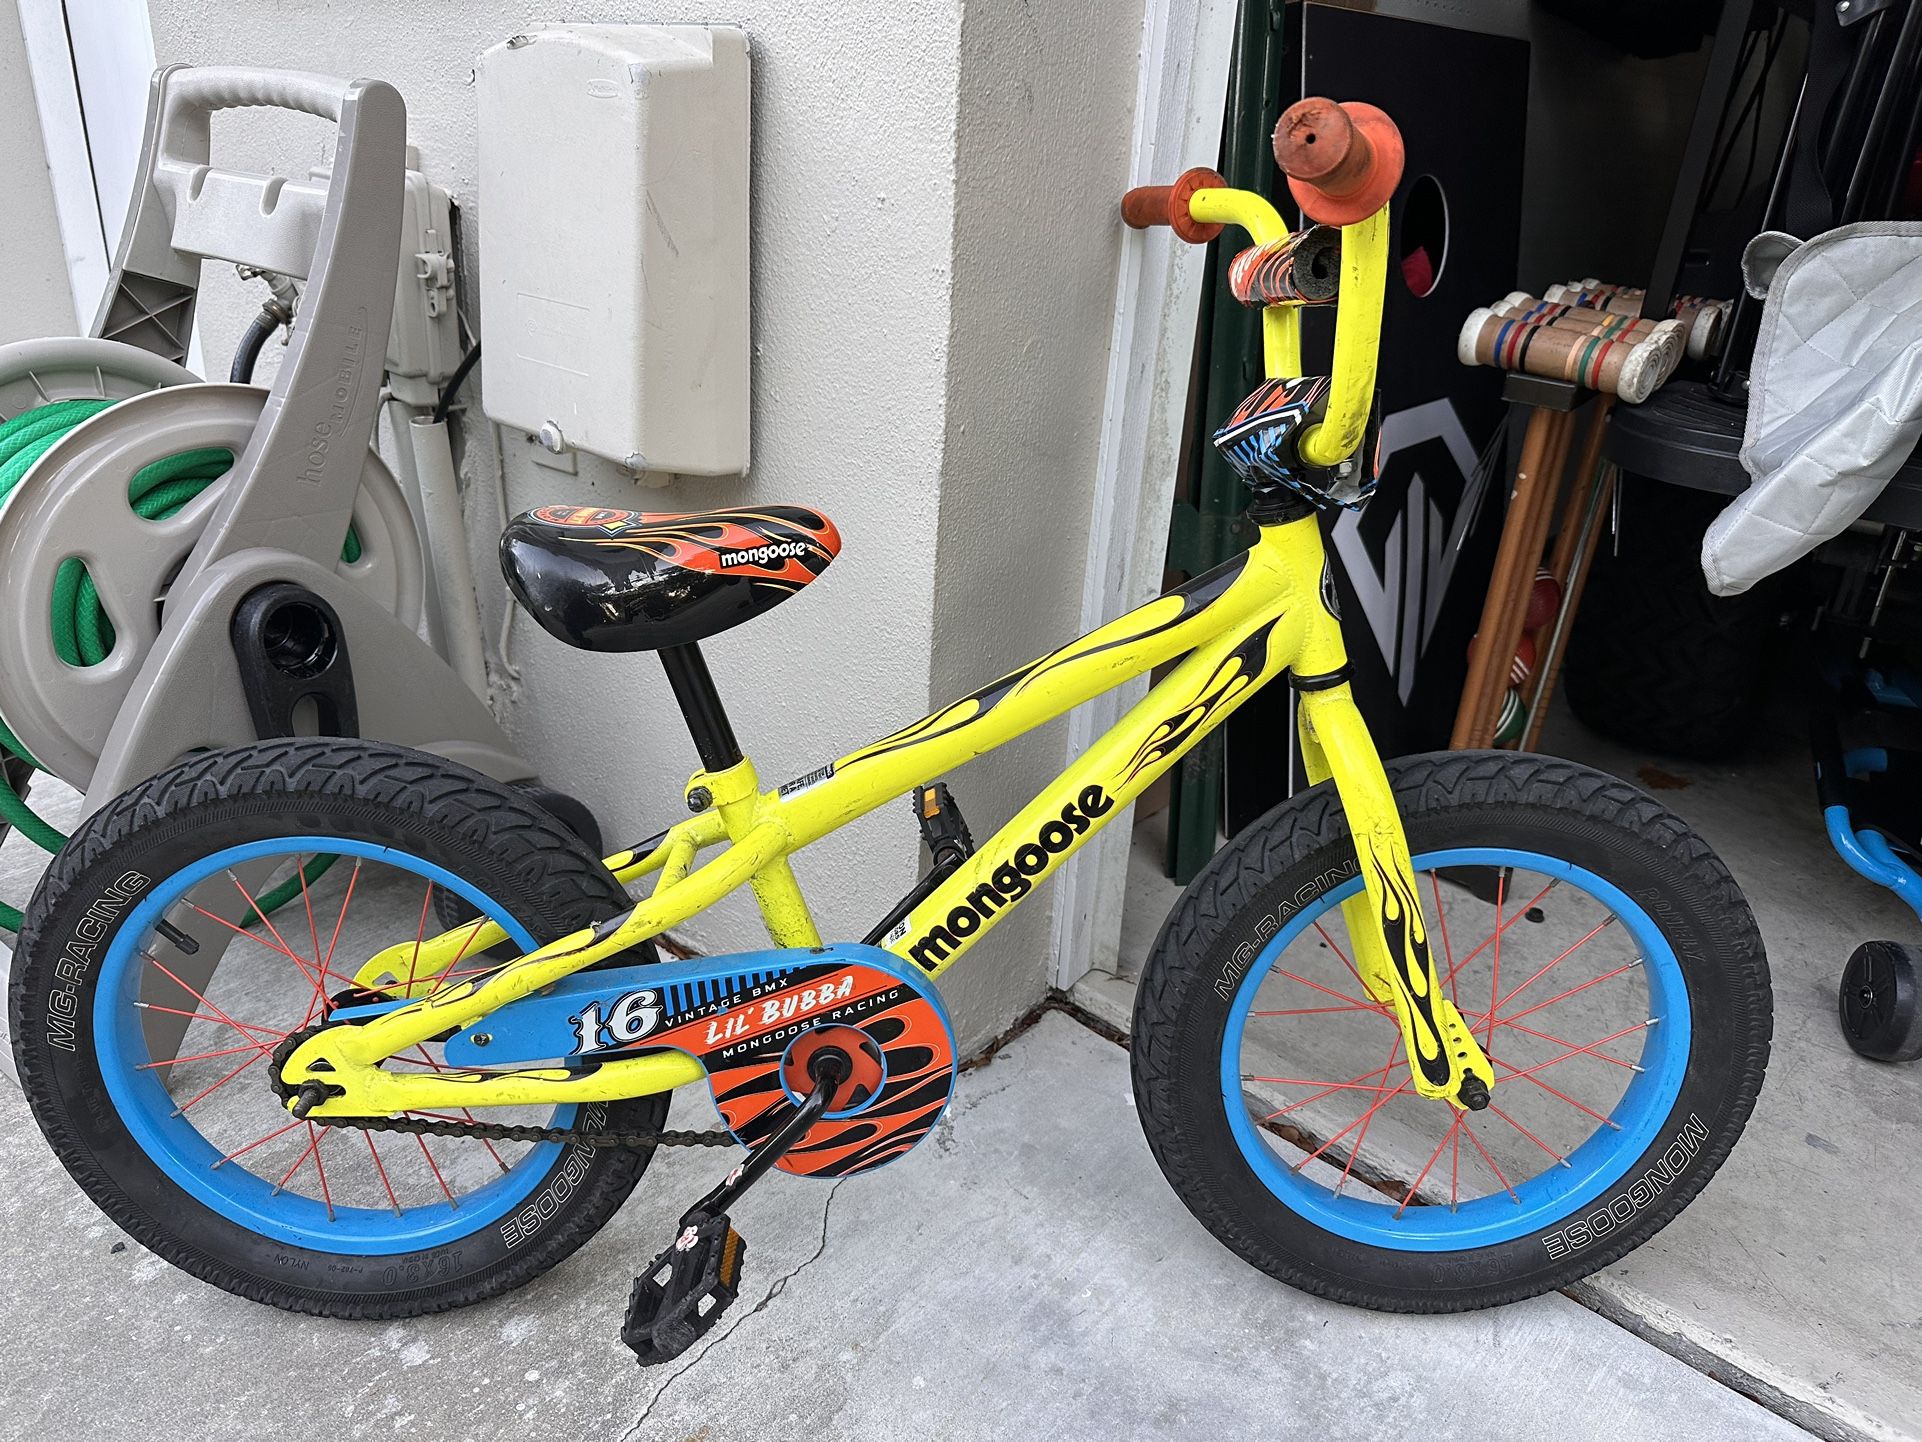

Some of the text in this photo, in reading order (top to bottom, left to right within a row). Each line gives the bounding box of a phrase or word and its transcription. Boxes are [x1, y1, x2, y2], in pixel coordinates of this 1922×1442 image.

[296, 421, 332, 487] hose
[720, 542, 808, 567] mongoose
[908, 785, 1115, 973] mongoose
[46, 870, 151, 1052] MG-RACING
[1213, 860, 1361, 1001] MG-RACIN
[572, 988, 662, 1055] 16
[664, 978, 788, 1027] VINTAGE BMX
[703, 975, 854, 1045] LIL' BUBBA
[722, 989, 899, 1059] MONGOOSE RACING
[1541, 1112, 1710, 1260] MONGOOSE
[273, 1253, 309, 1271] NYLON
